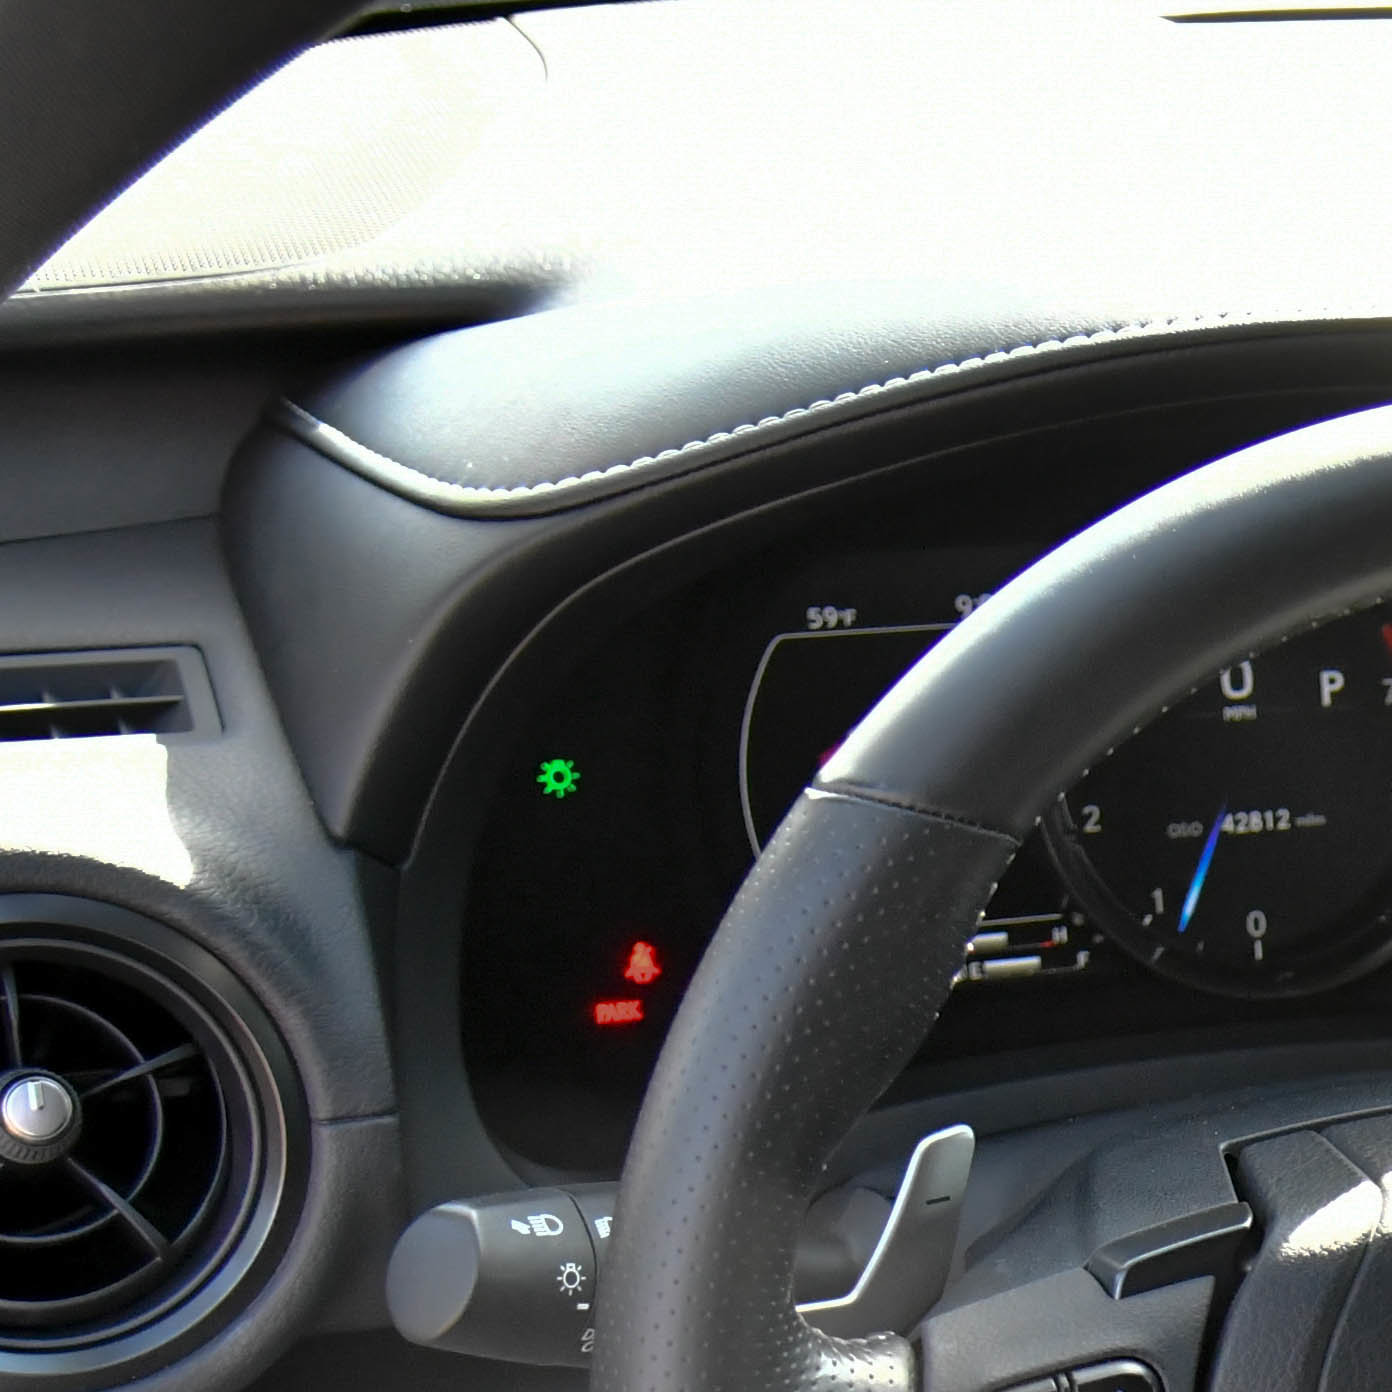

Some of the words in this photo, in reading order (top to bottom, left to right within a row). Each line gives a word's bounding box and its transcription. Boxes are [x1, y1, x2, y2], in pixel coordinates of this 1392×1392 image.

[1319, 669, 1345, 708] P
[1082, 804, 1102, 834] 2
[1220, 808, 1292, 834] 42812
[1151, 887, 1164, 915] 1
[1246, 909, 1268, 939] 0
[594, 1000, 643, 1024] PARK
